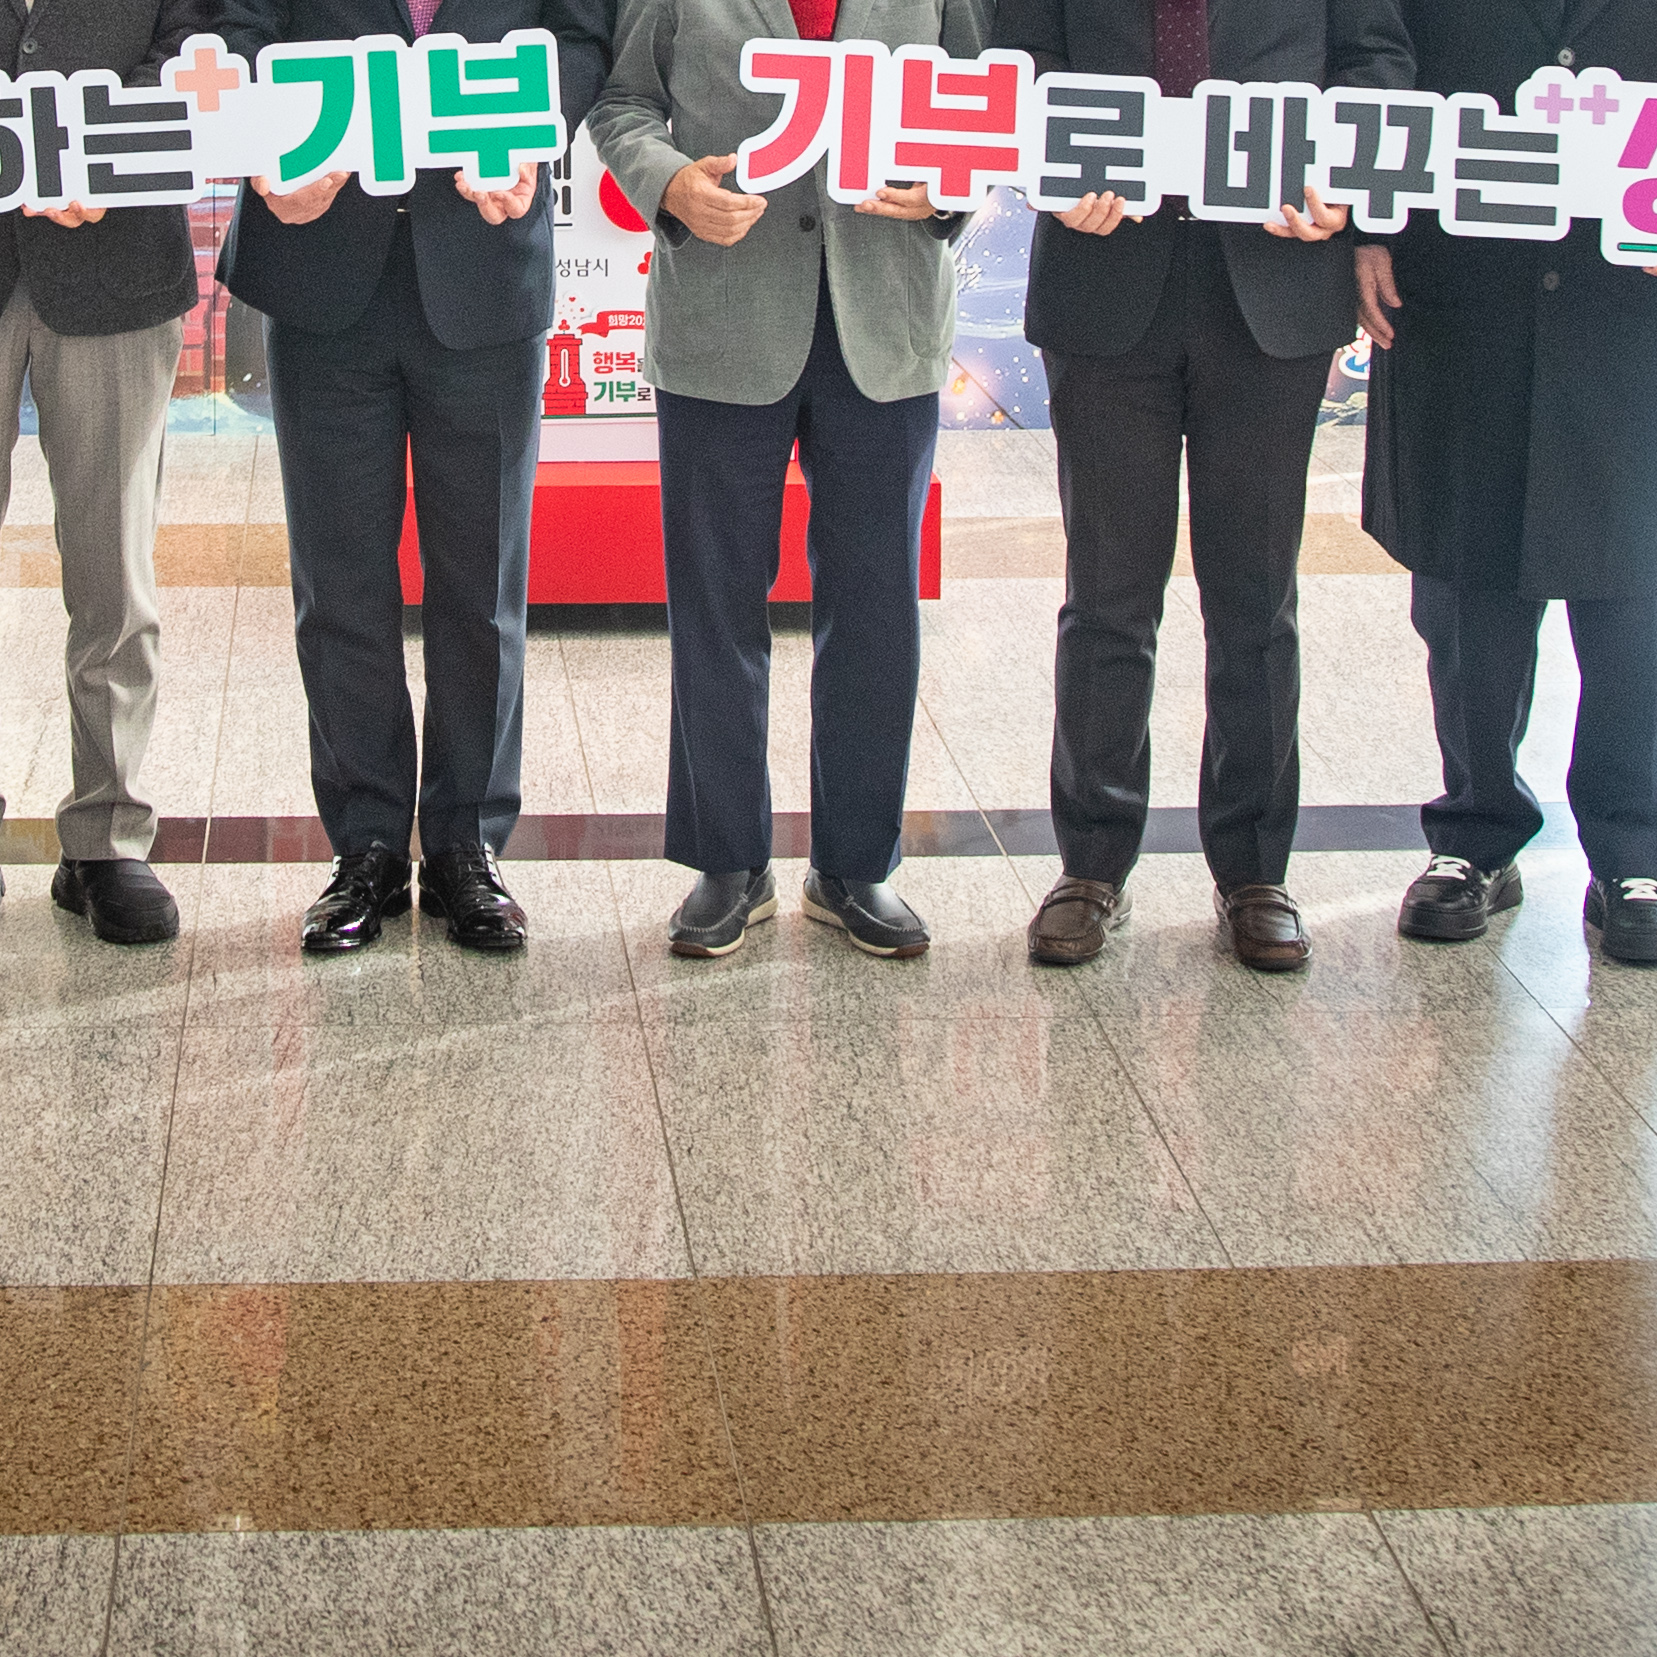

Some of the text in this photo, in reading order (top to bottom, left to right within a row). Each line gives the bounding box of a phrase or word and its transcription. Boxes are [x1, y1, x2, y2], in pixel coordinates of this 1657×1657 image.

[270, 44, 558, 183] 기부
[747, 52, 1147, 202] 기부로
[1201, 93, 1559, 226] 바꾸는
[555, 257, 610, 278] 성남시
[592, 380, 652, 402] 기부로
